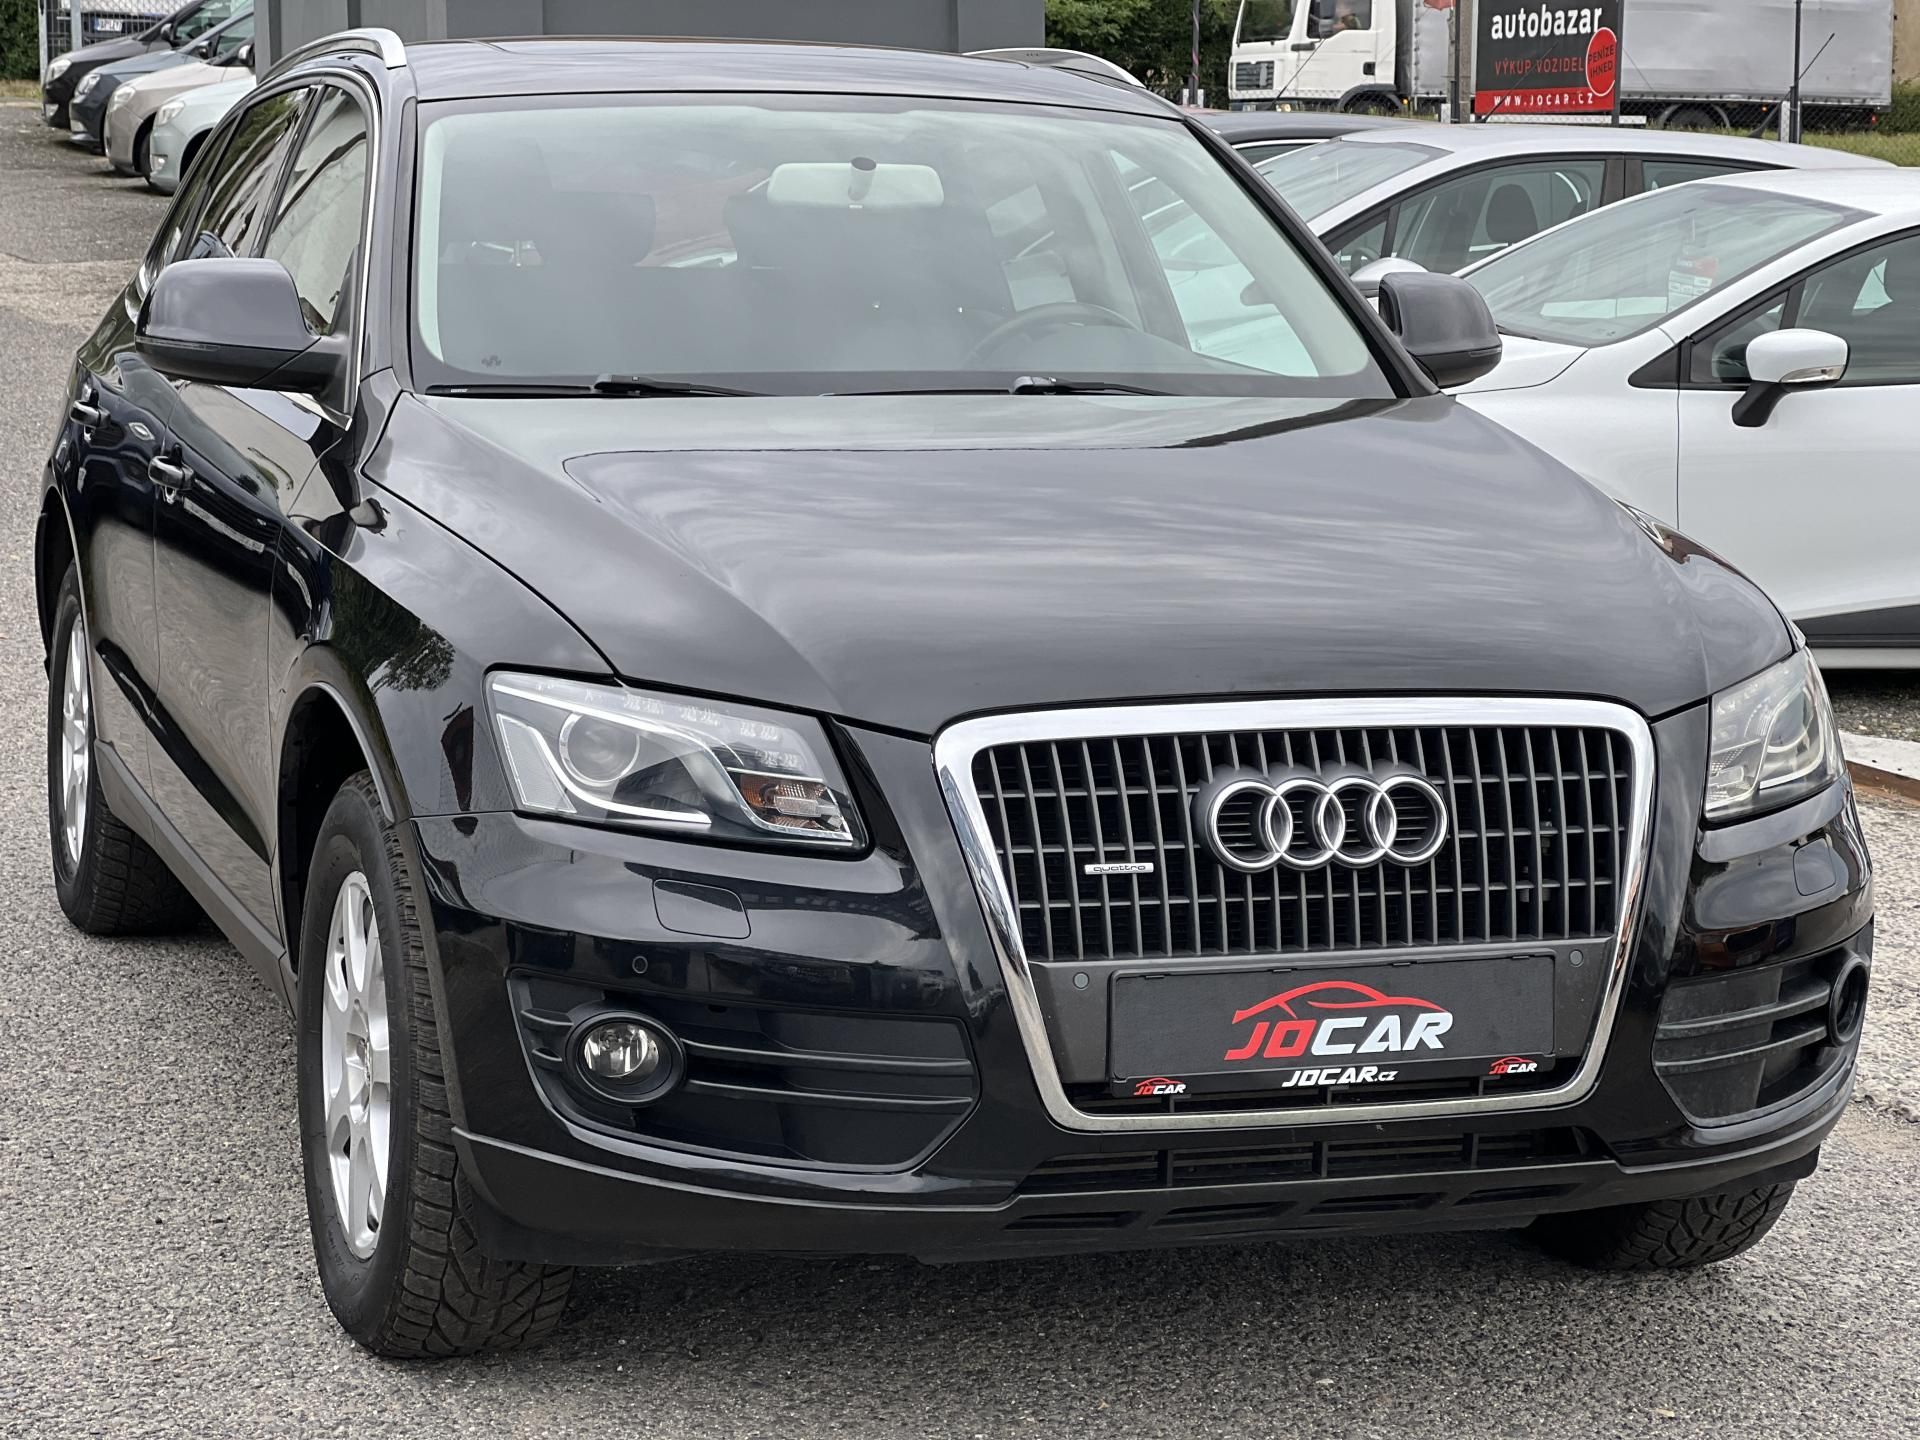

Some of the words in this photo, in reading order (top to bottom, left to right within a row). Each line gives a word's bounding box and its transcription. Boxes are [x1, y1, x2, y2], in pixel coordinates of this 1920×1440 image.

[1491, 4, 1603, 40] autobazar
[1494, 57, 1531, 76] VÝKUP
[1536, 57, 1584, 73] VOZIDEL
[1590, 61, 1614, 79] IHNED
[1493, 92, 1594, 107] WWW.JOCAR.CZ
[1093, 864, 1147, 873] quattro
[1223, 1011, 1454, 1061] JOCAR
[1281, 1065, 1399, 1088] JOCAR.cz
[1488, 1062, 1538, 1075] JOCAR
[1133, 1083, 1187, 1096] JOCAR
